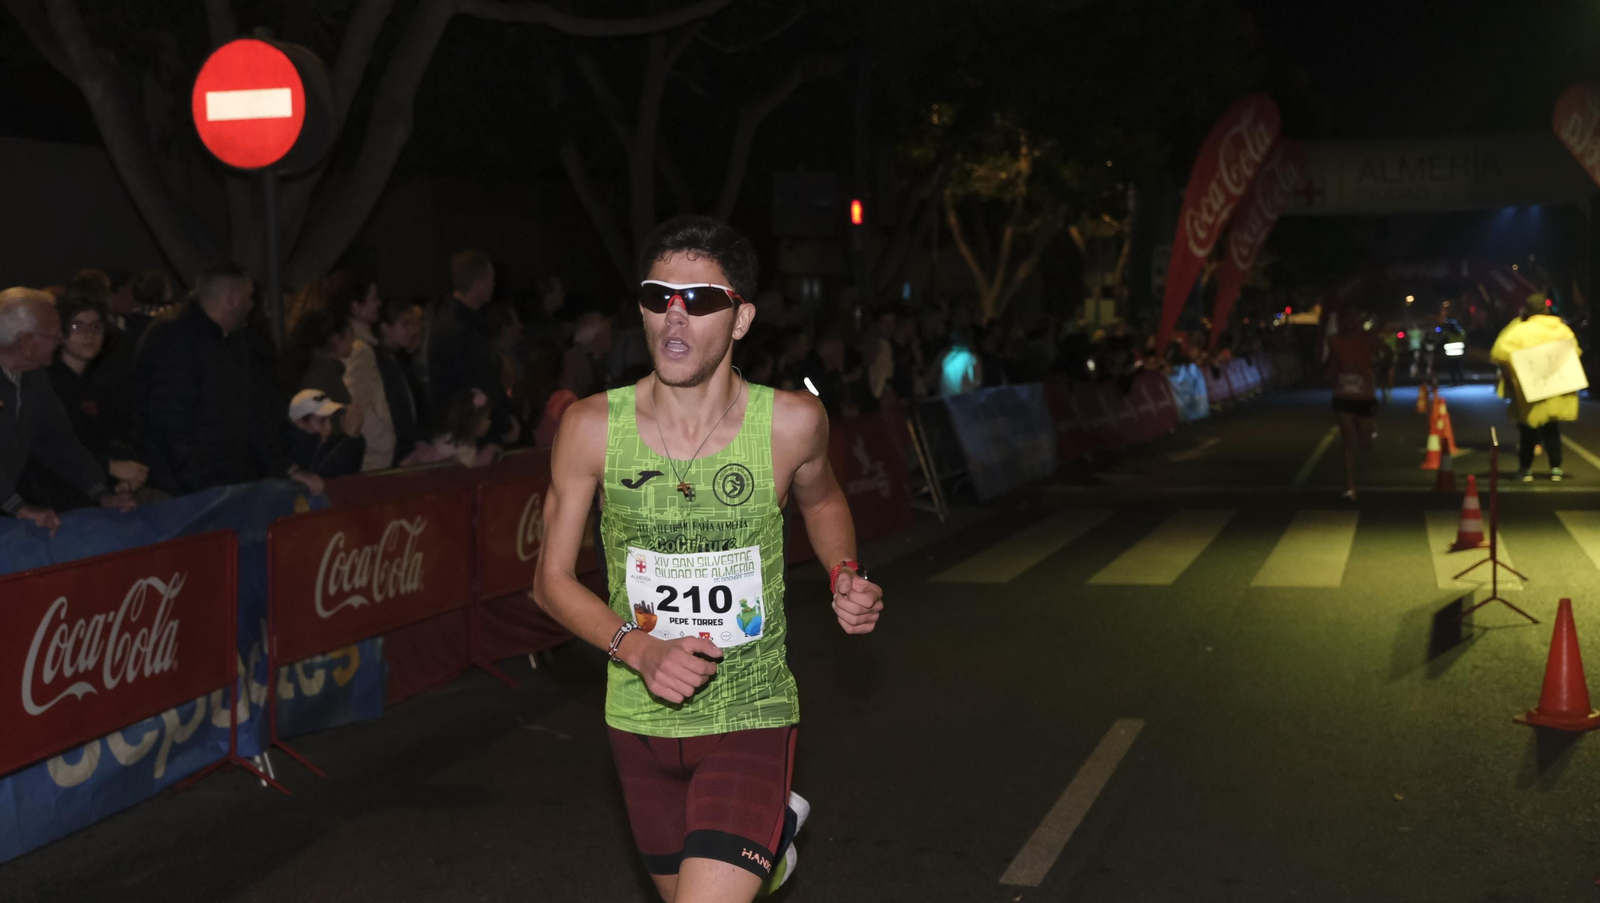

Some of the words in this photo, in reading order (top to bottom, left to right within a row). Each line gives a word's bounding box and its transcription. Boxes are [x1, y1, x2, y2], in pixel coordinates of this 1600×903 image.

[1185, 102, 1271, 258] Coca-Cola
[314, 515, 429, 619] Coca-Cola
[654, 555, 670, 567] XIV
[672, 557, 694, 568] SAN
[697, 550, 752, 567] SILVESTRE
[655, 567, 692, 579] CIUDAD
[695, 568, 708, 579] DE
[656, 585, 732, 614] 210
[669, 617, 689, 626] PEPE
[692, 618, 724, 626] TORRES
[21, 569, 188, 716] Coca-Cola
